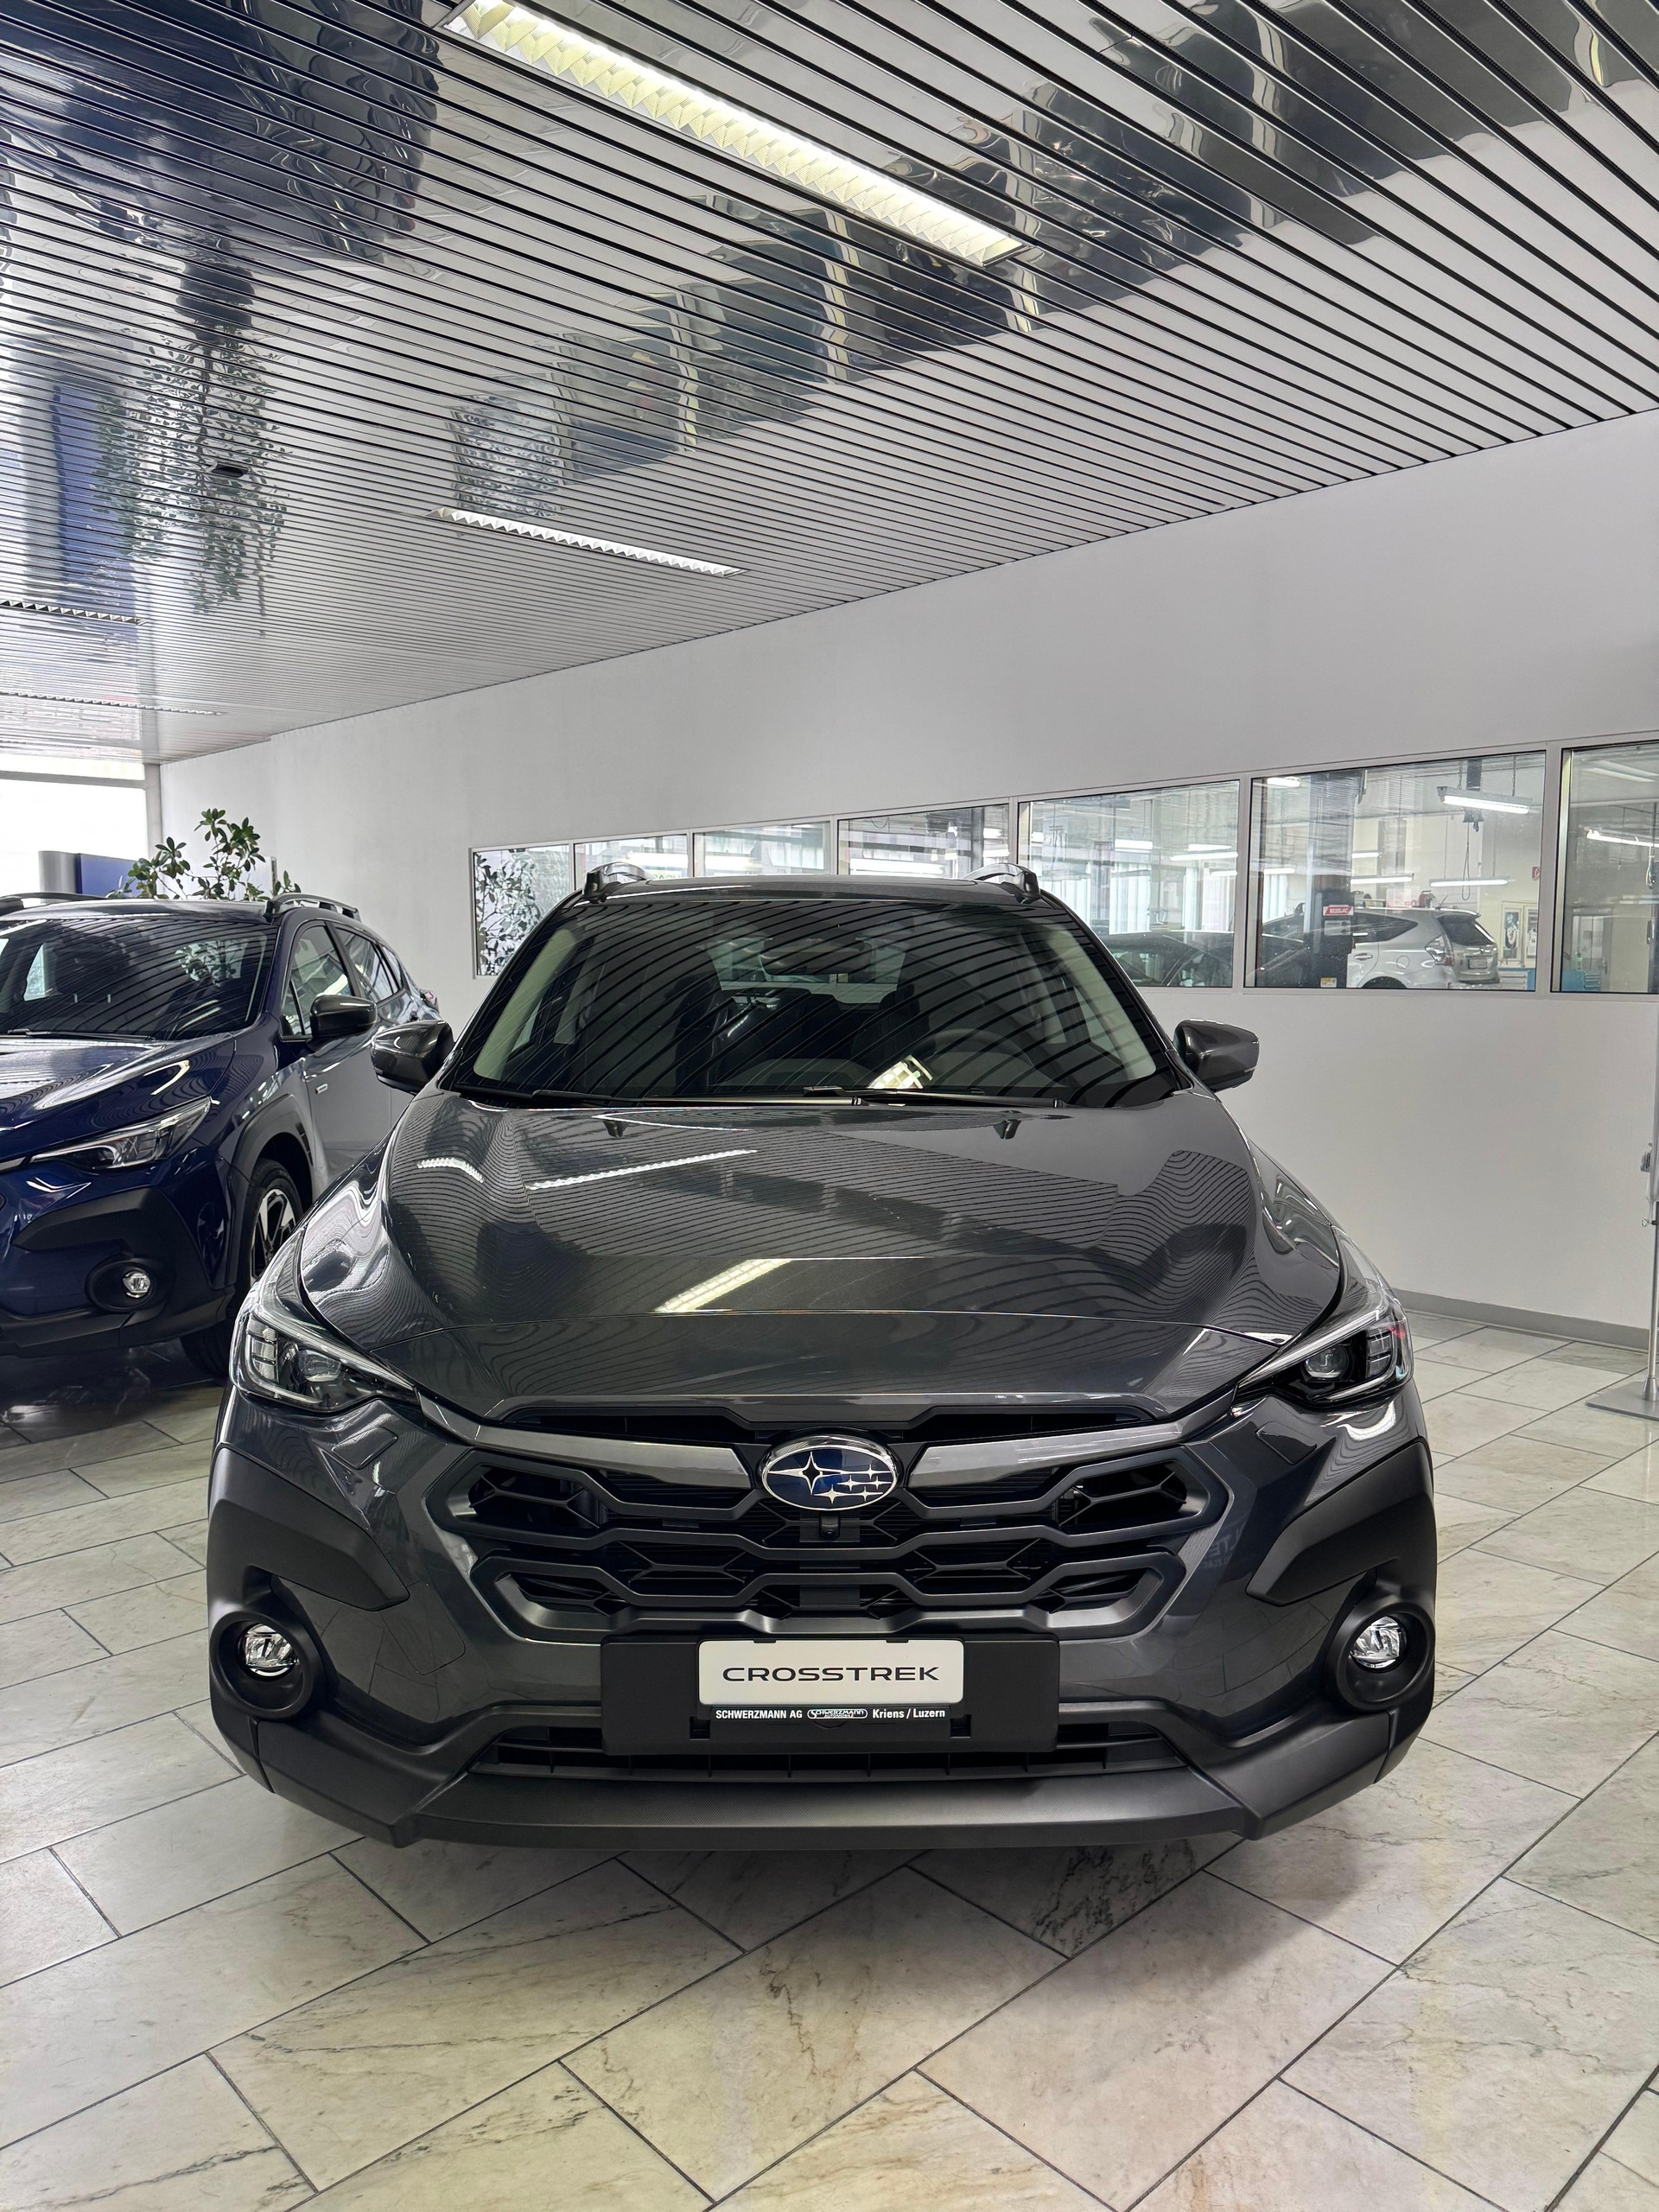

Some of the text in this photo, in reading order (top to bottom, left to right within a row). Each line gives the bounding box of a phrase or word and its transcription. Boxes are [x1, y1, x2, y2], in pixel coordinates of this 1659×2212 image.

[722, 1667, 939, 1681] CROSSTREK
[715, 1710, 803, 1719] SCHWERZMANN AG
[872, 1708, 945, 1719] Kriens / Luzern
